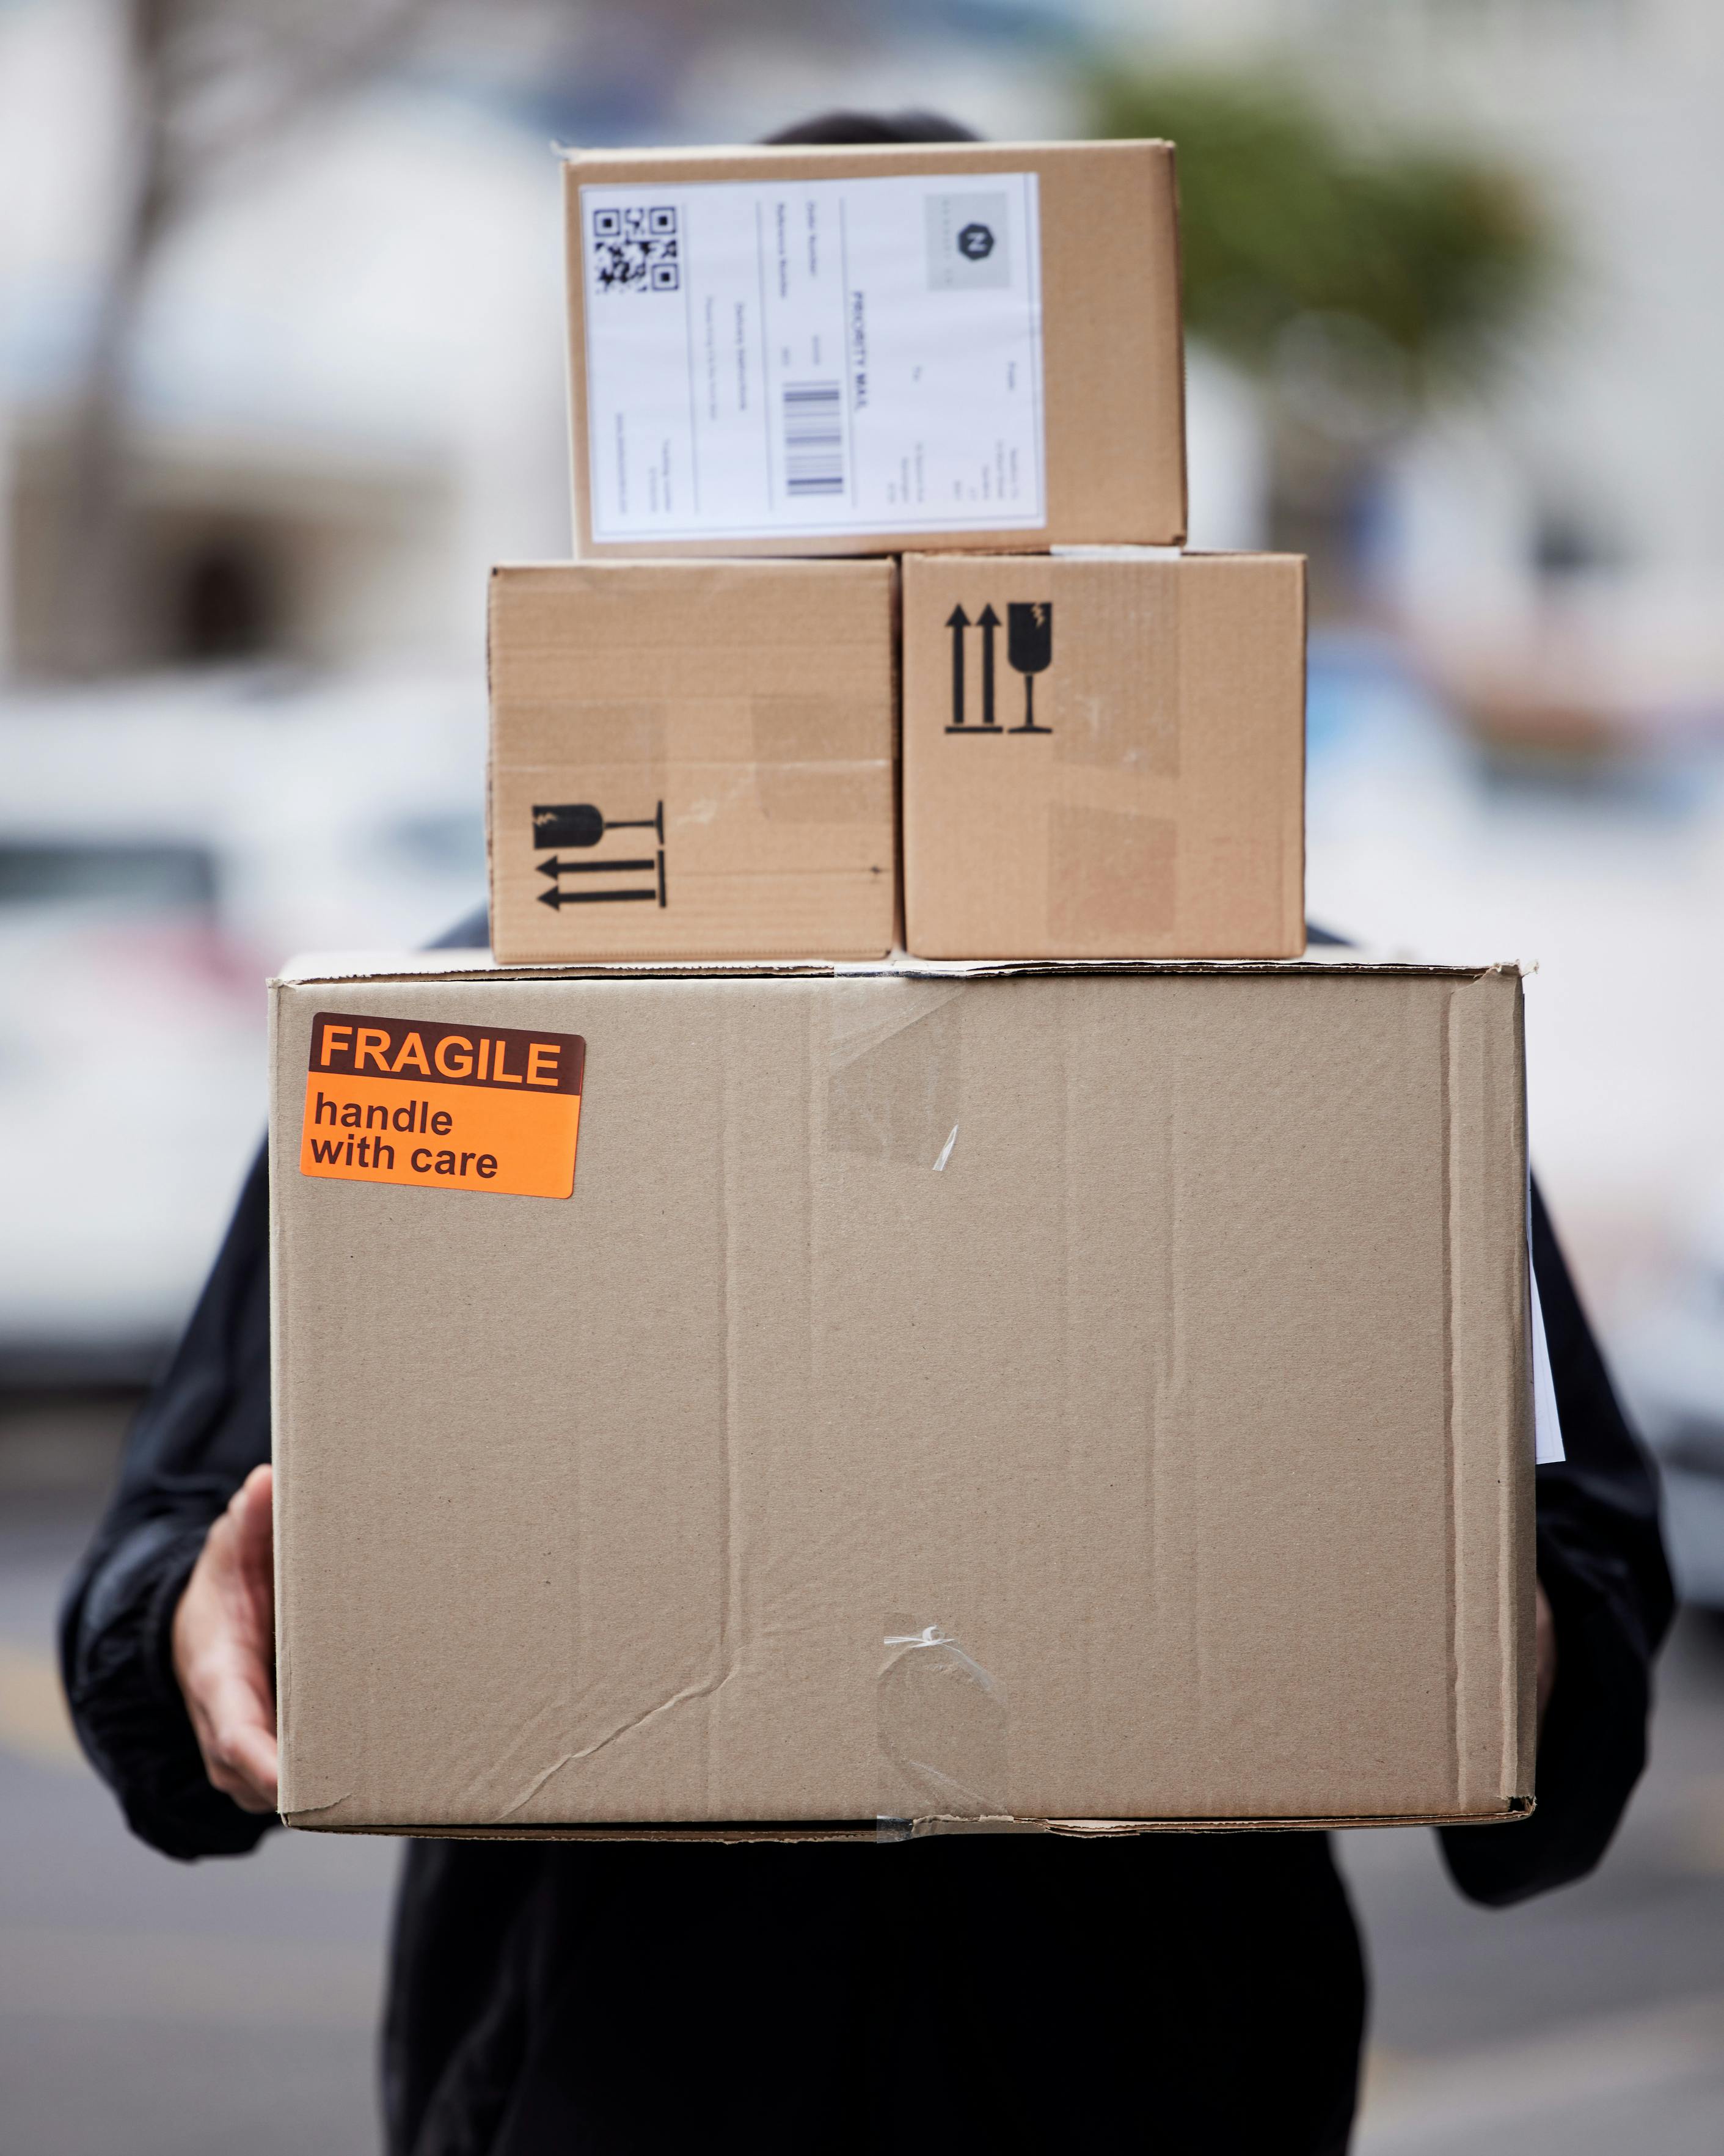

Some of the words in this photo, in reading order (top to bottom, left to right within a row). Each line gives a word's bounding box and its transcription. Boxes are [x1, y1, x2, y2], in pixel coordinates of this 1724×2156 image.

[966, 232, 986, 252] N
[850, 291, 866, 366] PRIORITY
[854, 373, 868, 411] MAIL
[320, 1025, 561, 1086] FRAGILE
[315, 1092, 453, 1135] handle
[310, 1134, 395, 1169] with
[411, 1148, 498, 1178] care
